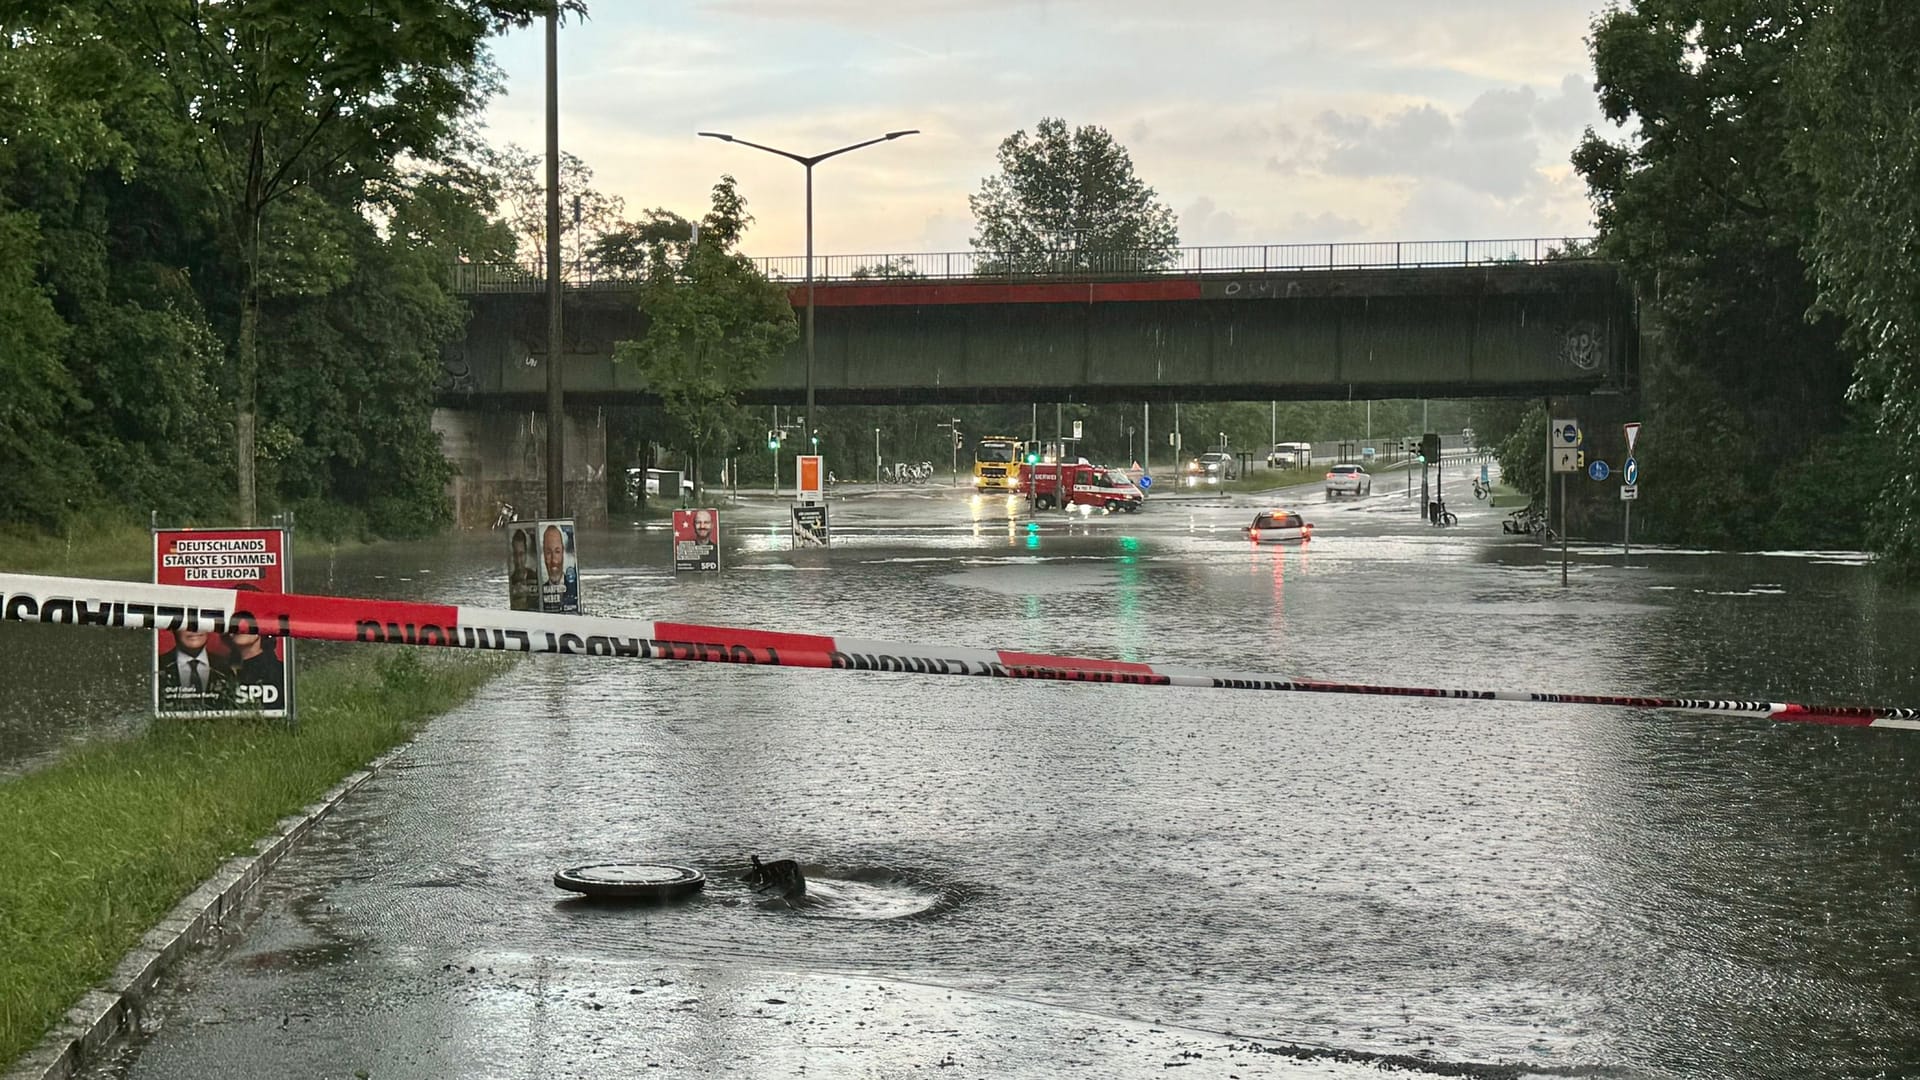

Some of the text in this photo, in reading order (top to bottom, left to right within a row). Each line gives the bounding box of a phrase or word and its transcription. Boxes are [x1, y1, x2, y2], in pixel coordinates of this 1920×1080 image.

[178, 541, 264, 552] DEUTSCHLANDS
[165, 554, 275, 566] STÄRKSTE STIMMEN
[700, 561, 717, 570] SPD
[186, 567, 257, 579] FÜR EUROPA
[235, 685, 279, 704] SPD
